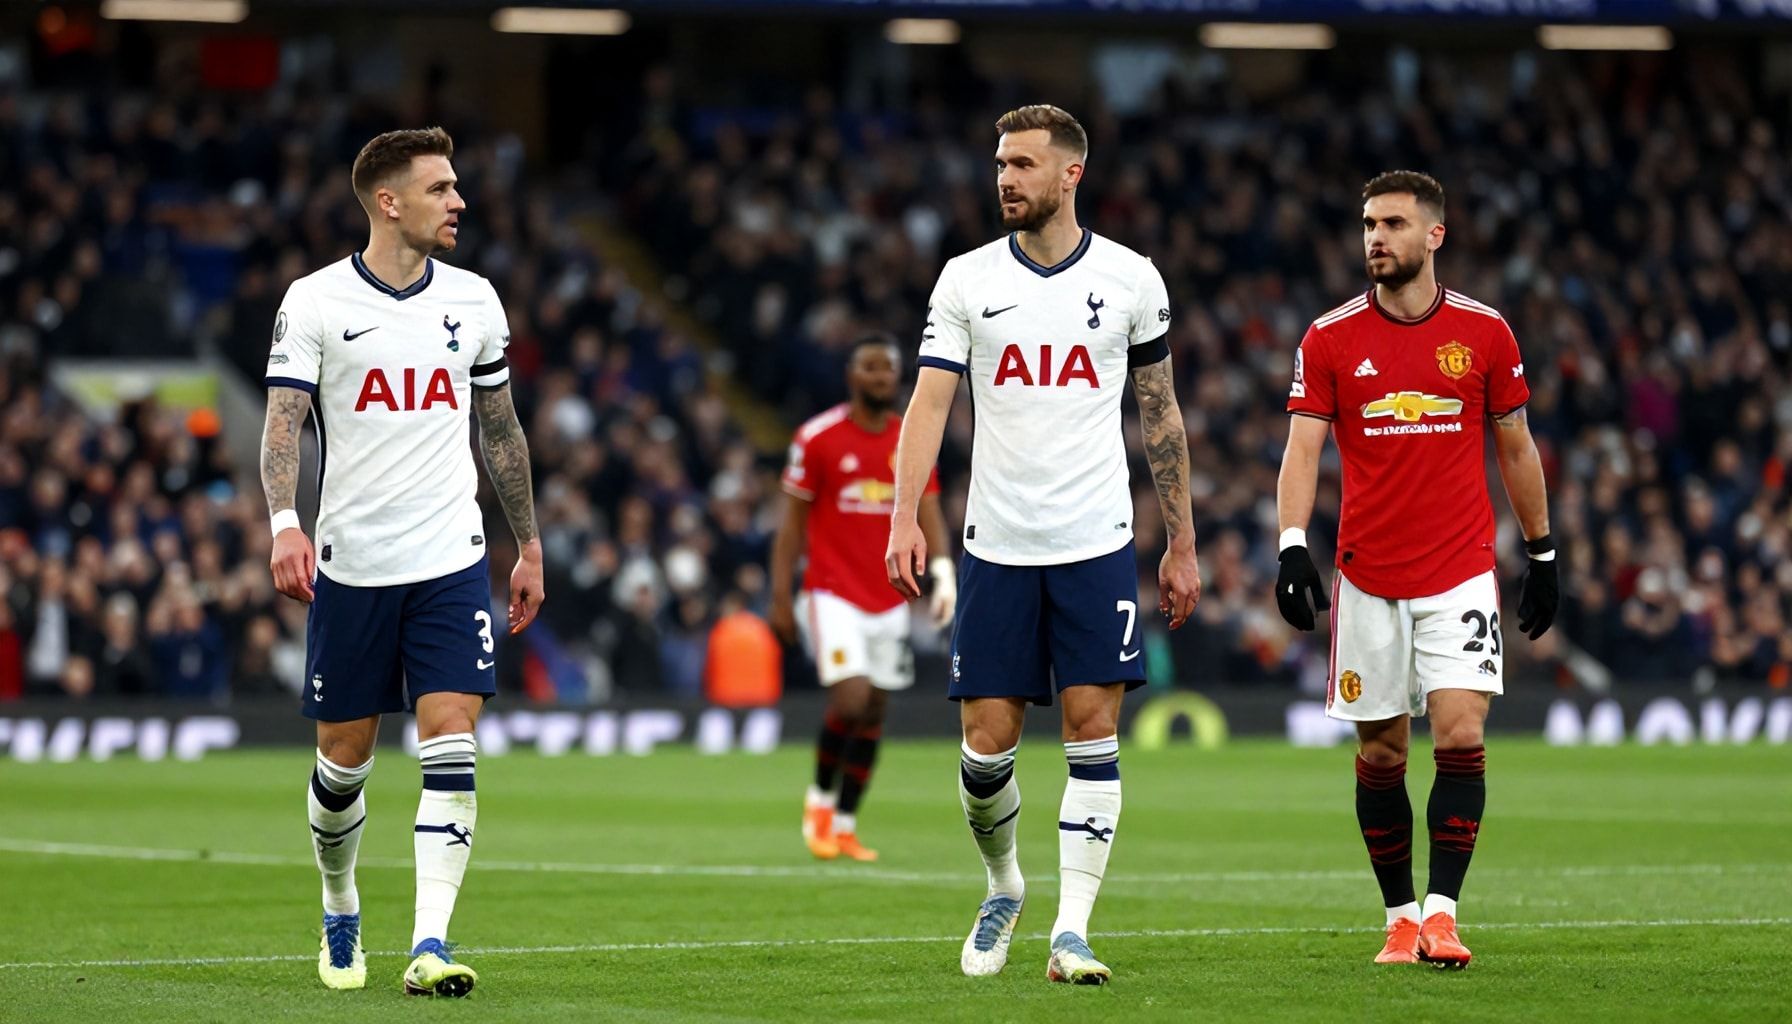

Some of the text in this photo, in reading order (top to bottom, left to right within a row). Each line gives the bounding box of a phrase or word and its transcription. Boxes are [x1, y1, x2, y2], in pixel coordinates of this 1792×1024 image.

[993, 343, 1100, 389] AIA
[354, 367, 459, 412] AIA
[474, 609, 494, 653] 3
[1116, 600, 1136, 646] 7
